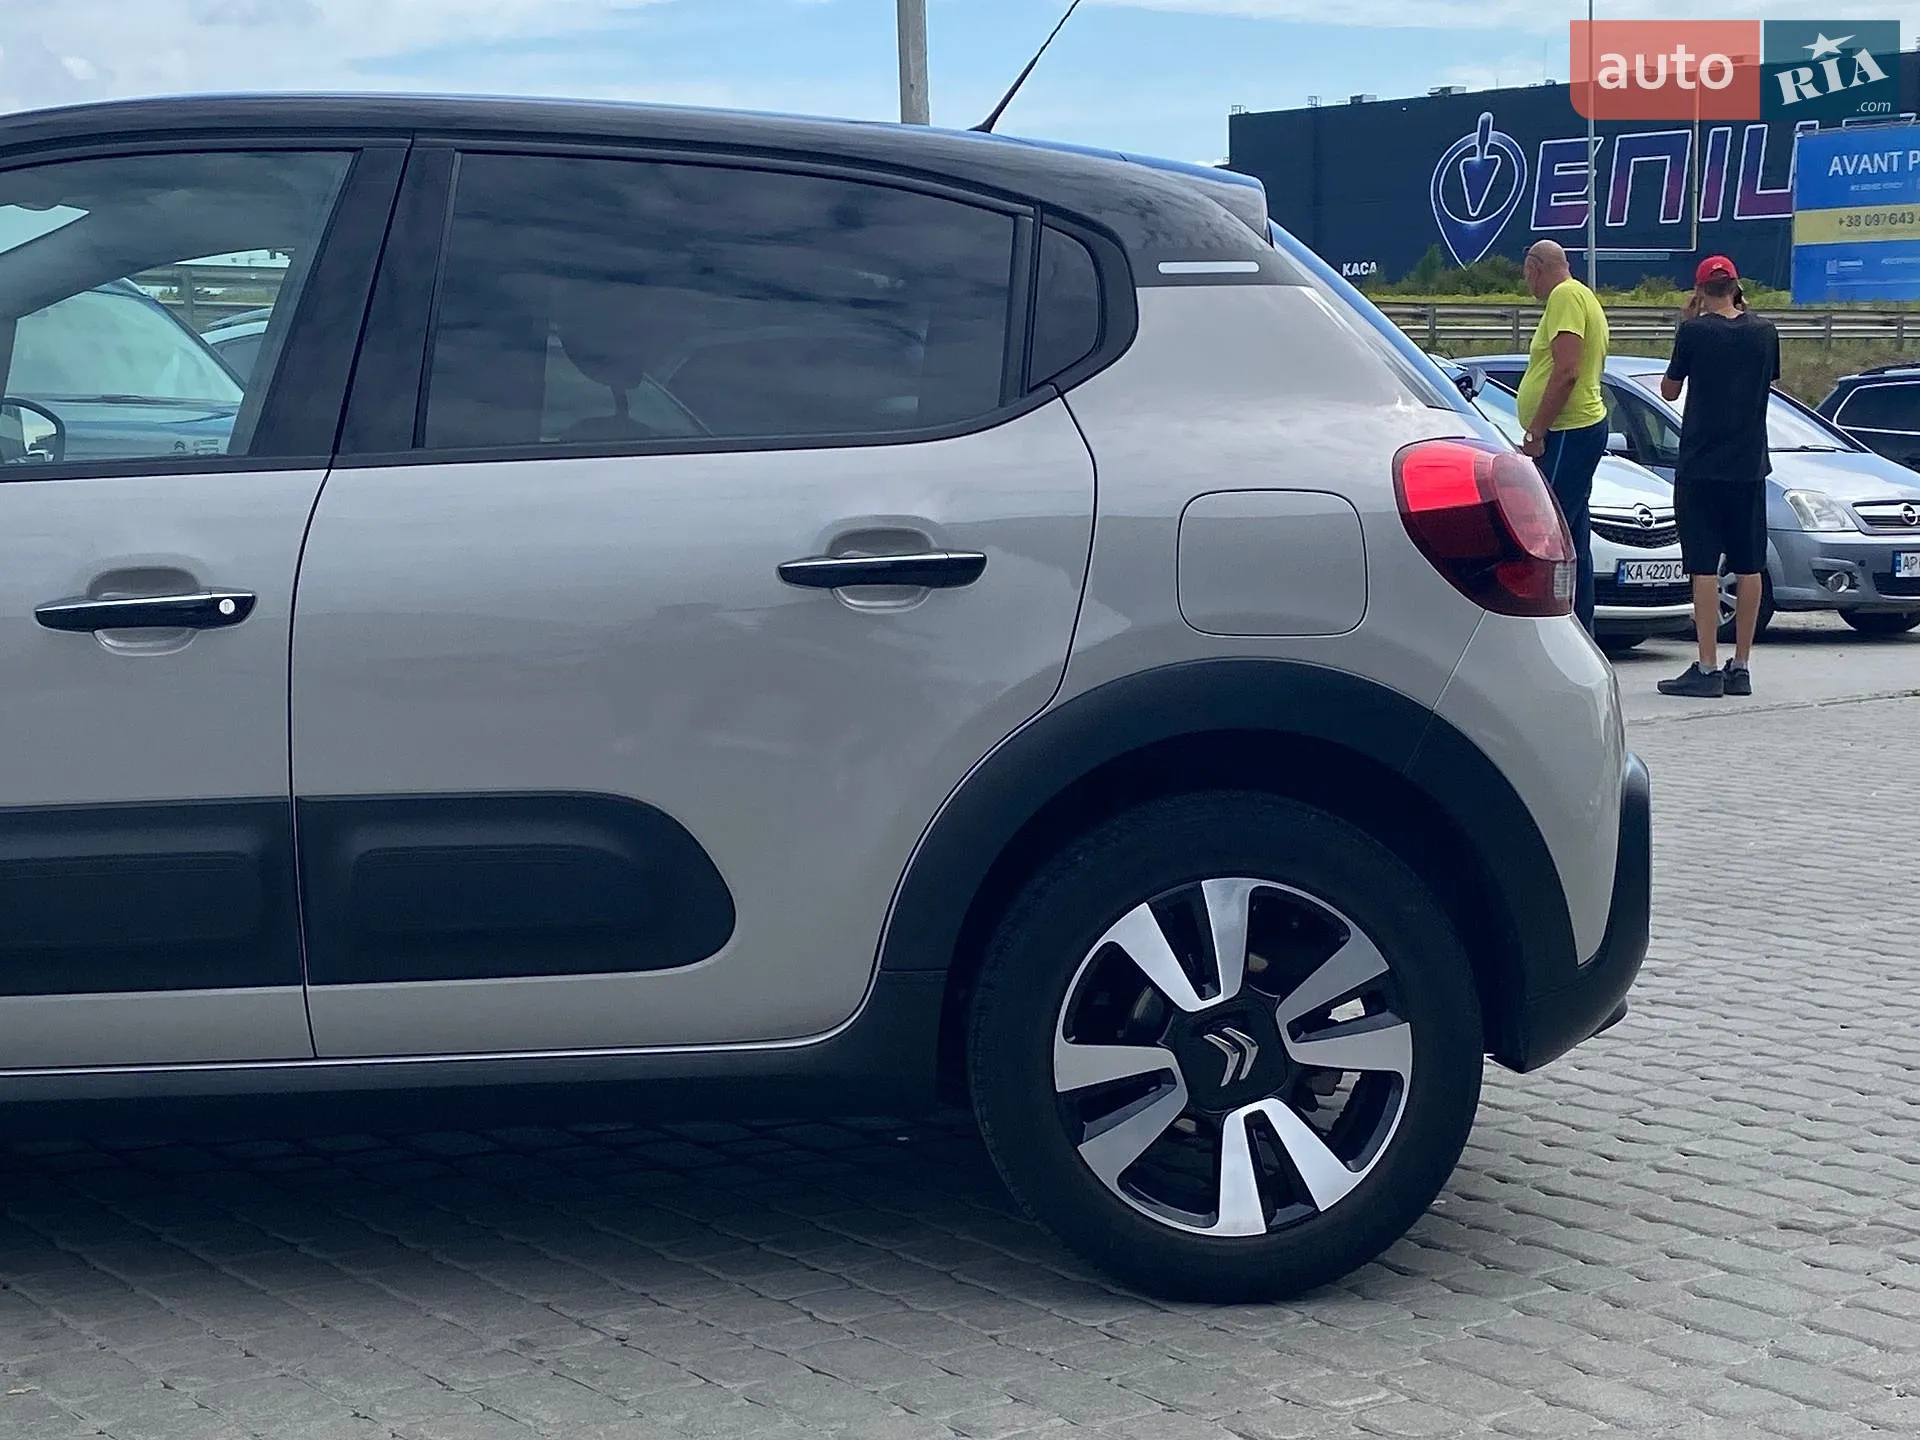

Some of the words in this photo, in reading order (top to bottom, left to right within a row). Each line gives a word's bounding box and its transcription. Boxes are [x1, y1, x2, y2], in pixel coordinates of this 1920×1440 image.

[1828, 150, 1904, 177] AVANT
[1838, 214, 1862, 228] +38
[1889, 211, 1915, 225] 643
[1342, 261, 1377, 277] КАСА
[1626, 564, 1643, 580] KA
[1646, 563, 1672, 580] 4220
